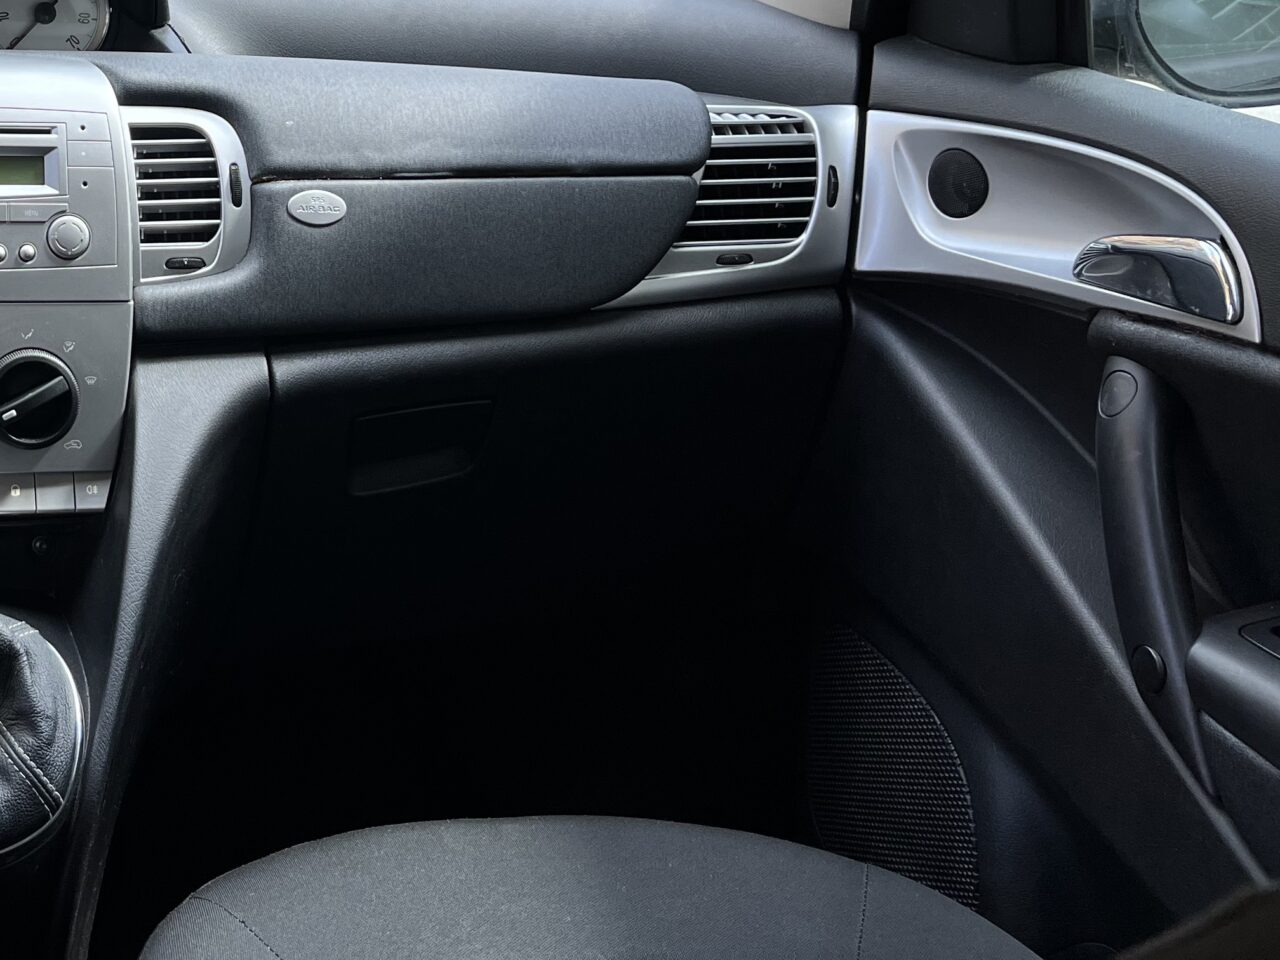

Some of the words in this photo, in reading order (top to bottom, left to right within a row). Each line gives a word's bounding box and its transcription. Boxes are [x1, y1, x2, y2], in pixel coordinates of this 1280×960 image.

[77, 12, 91, 24] 60
[65, 35, 80, 49] 70
[296, 204, 316, 213] AIR
[318, 205, 340, 214] BAG
